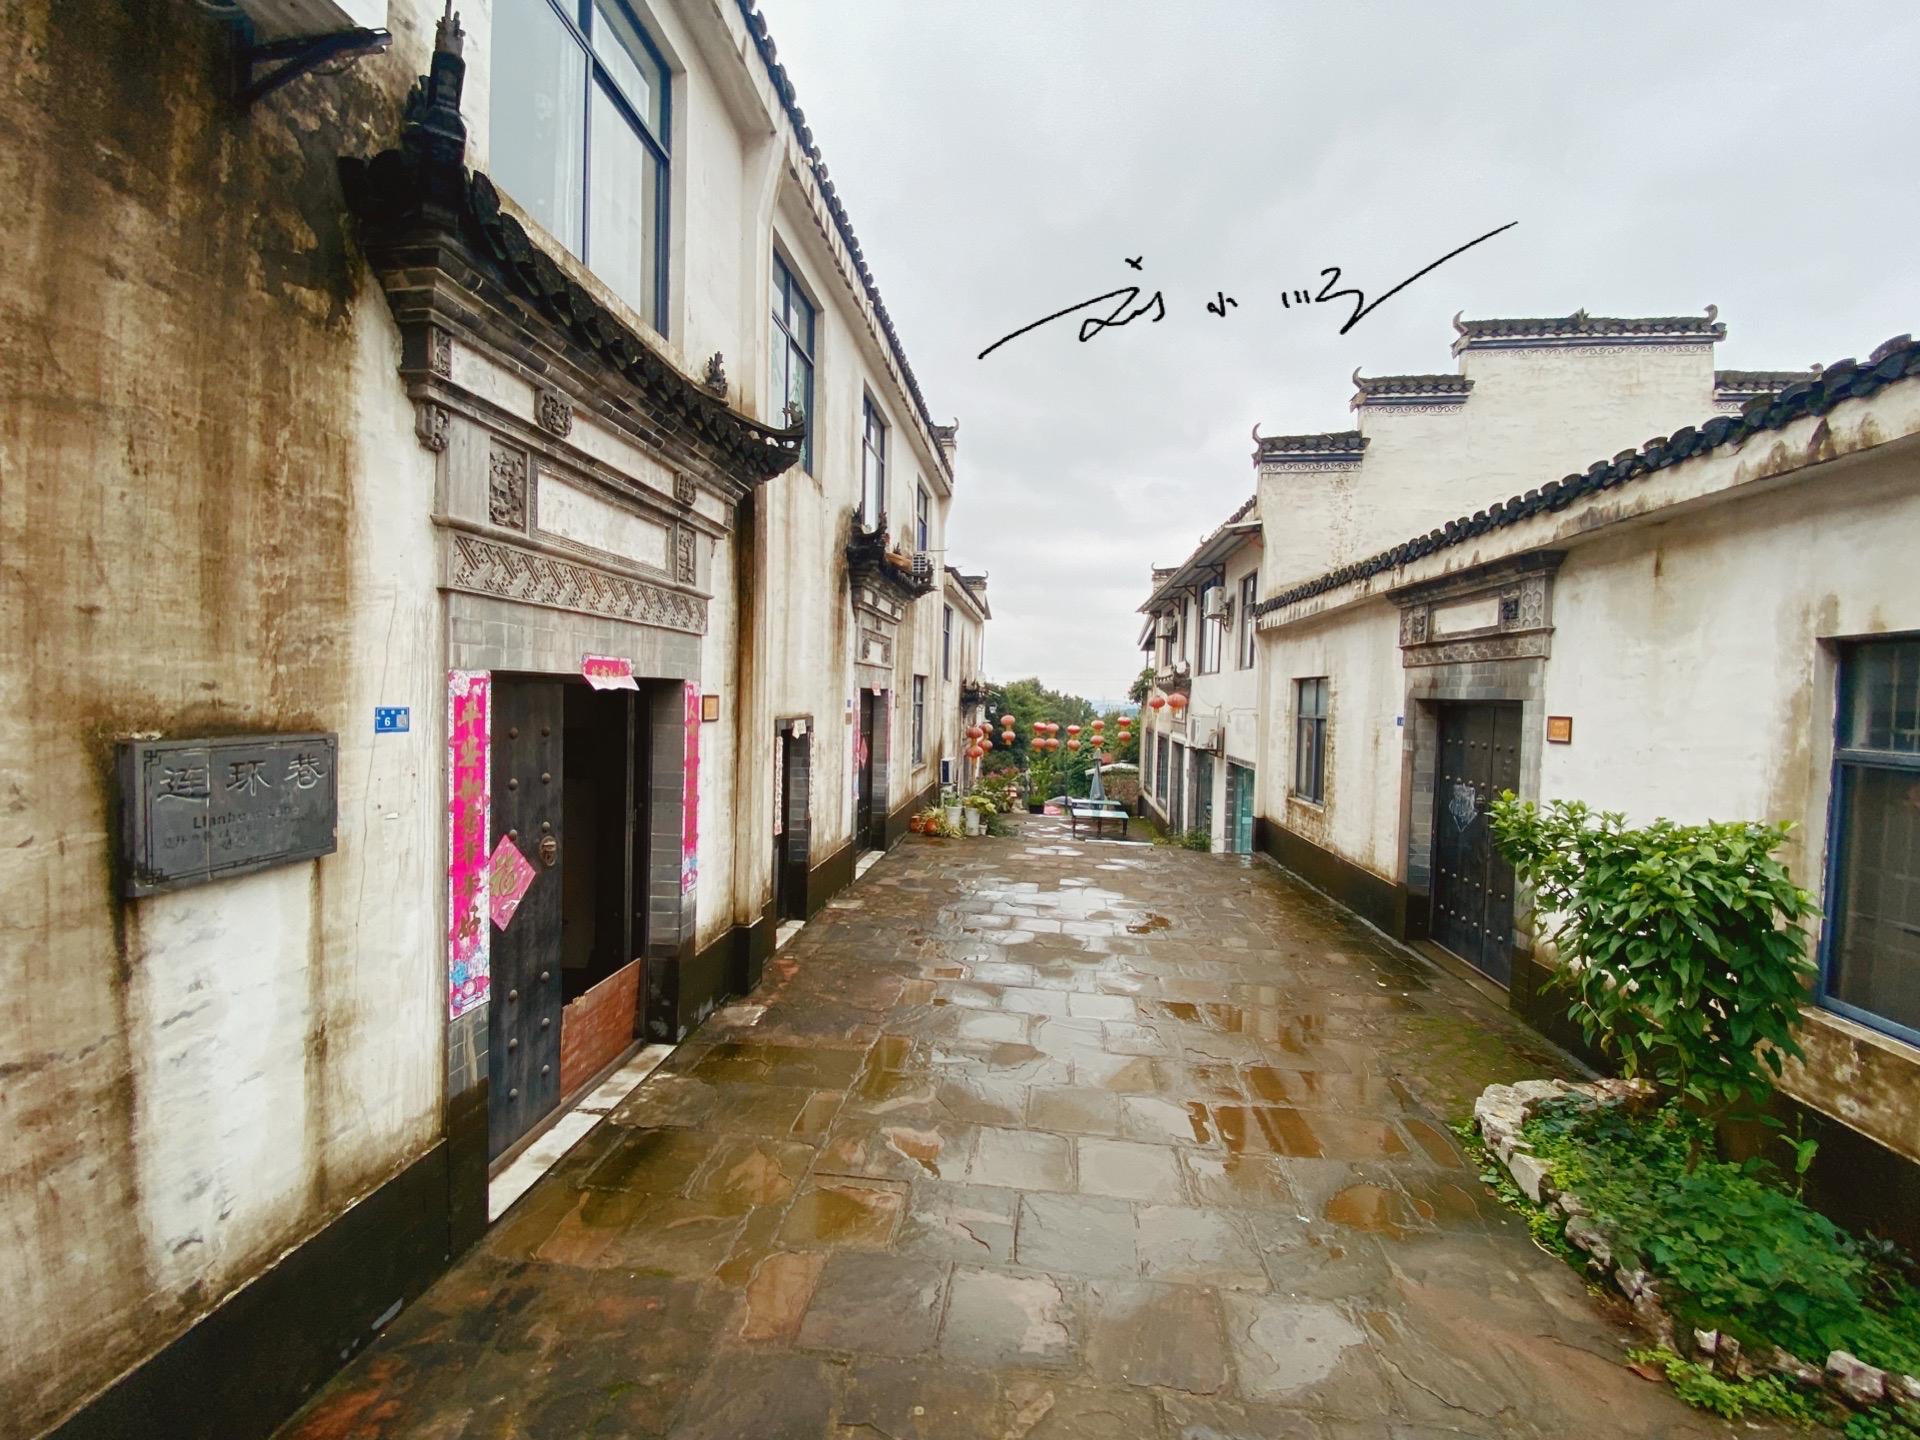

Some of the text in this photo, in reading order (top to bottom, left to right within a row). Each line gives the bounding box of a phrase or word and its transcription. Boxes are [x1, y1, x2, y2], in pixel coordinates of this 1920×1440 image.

[384, 716, 391, 727] 6
[157, 752, 327, 802] 连环巷
